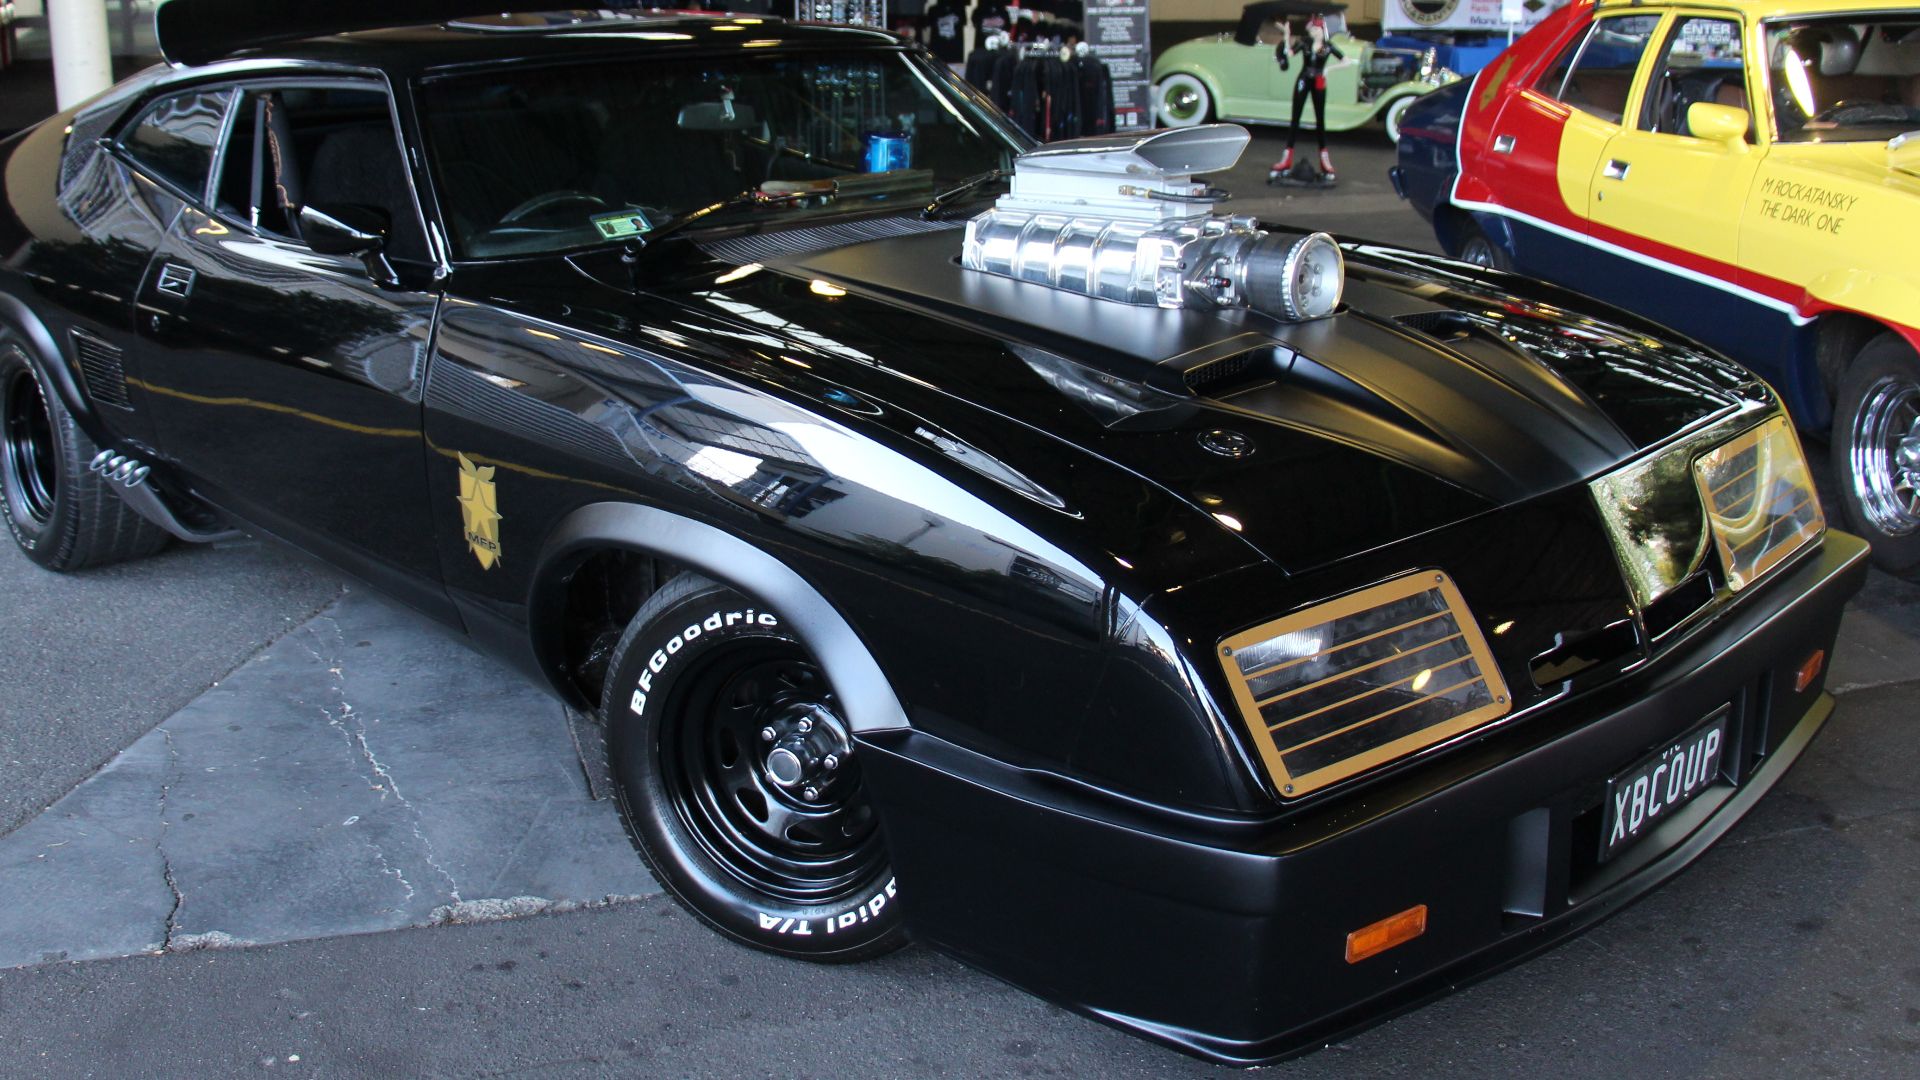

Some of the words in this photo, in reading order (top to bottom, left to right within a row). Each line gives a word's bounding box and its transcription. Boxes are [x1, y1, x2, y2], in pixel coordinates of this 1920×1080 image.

[1683, 23, 1731, 34] ENTER
[1761, 178, 1774, 193] M
[1774, 180, 1858, 212] ROCKATANSKY
[1760, 199, 1782, 218] THE
[1782, 205, 1816, 227] DARK
[1817, 214, 1846, 234] ONE
[468, 531, 497, 550] MFP
[630, 609, 778, 716] BFGoodric
[1609, 728, 1720, 847] XBCOUP
[827, 876, 897, 934] adial
[759, 912, 812, 935] T/A
